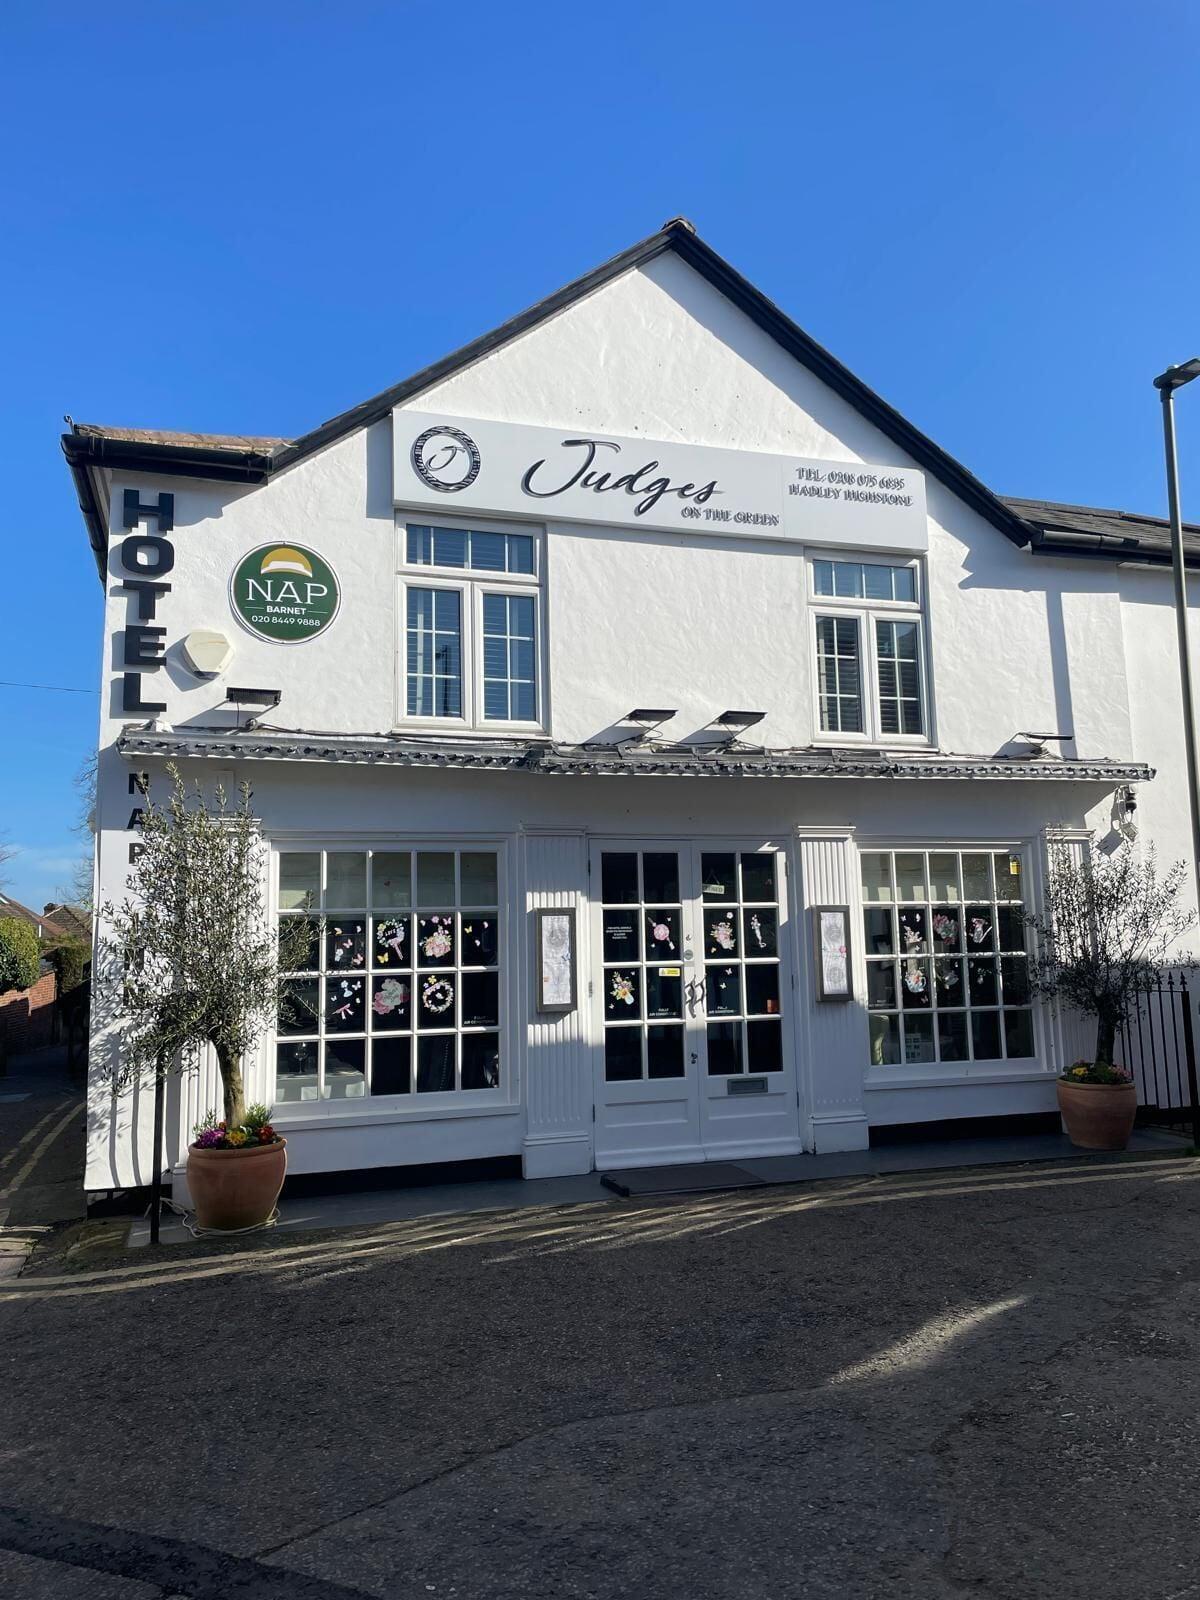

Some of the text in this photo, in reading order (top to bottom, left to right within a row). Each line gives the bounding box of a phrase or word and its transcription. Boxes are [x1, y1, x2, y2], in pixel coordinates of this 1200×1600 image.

[521, 439, 725, 517] Judges
[788, 483, 914, 507] HADLEY HIGHSTONE
[681, 506, 780, 527] ON THE GREEN
[121, 488, 175, 712] HOTEL
[245, 578, 329, 605] NAP
[251, 615, 321, 627] 020 8449 9888
[266, 605, 307, 616] BARNET
